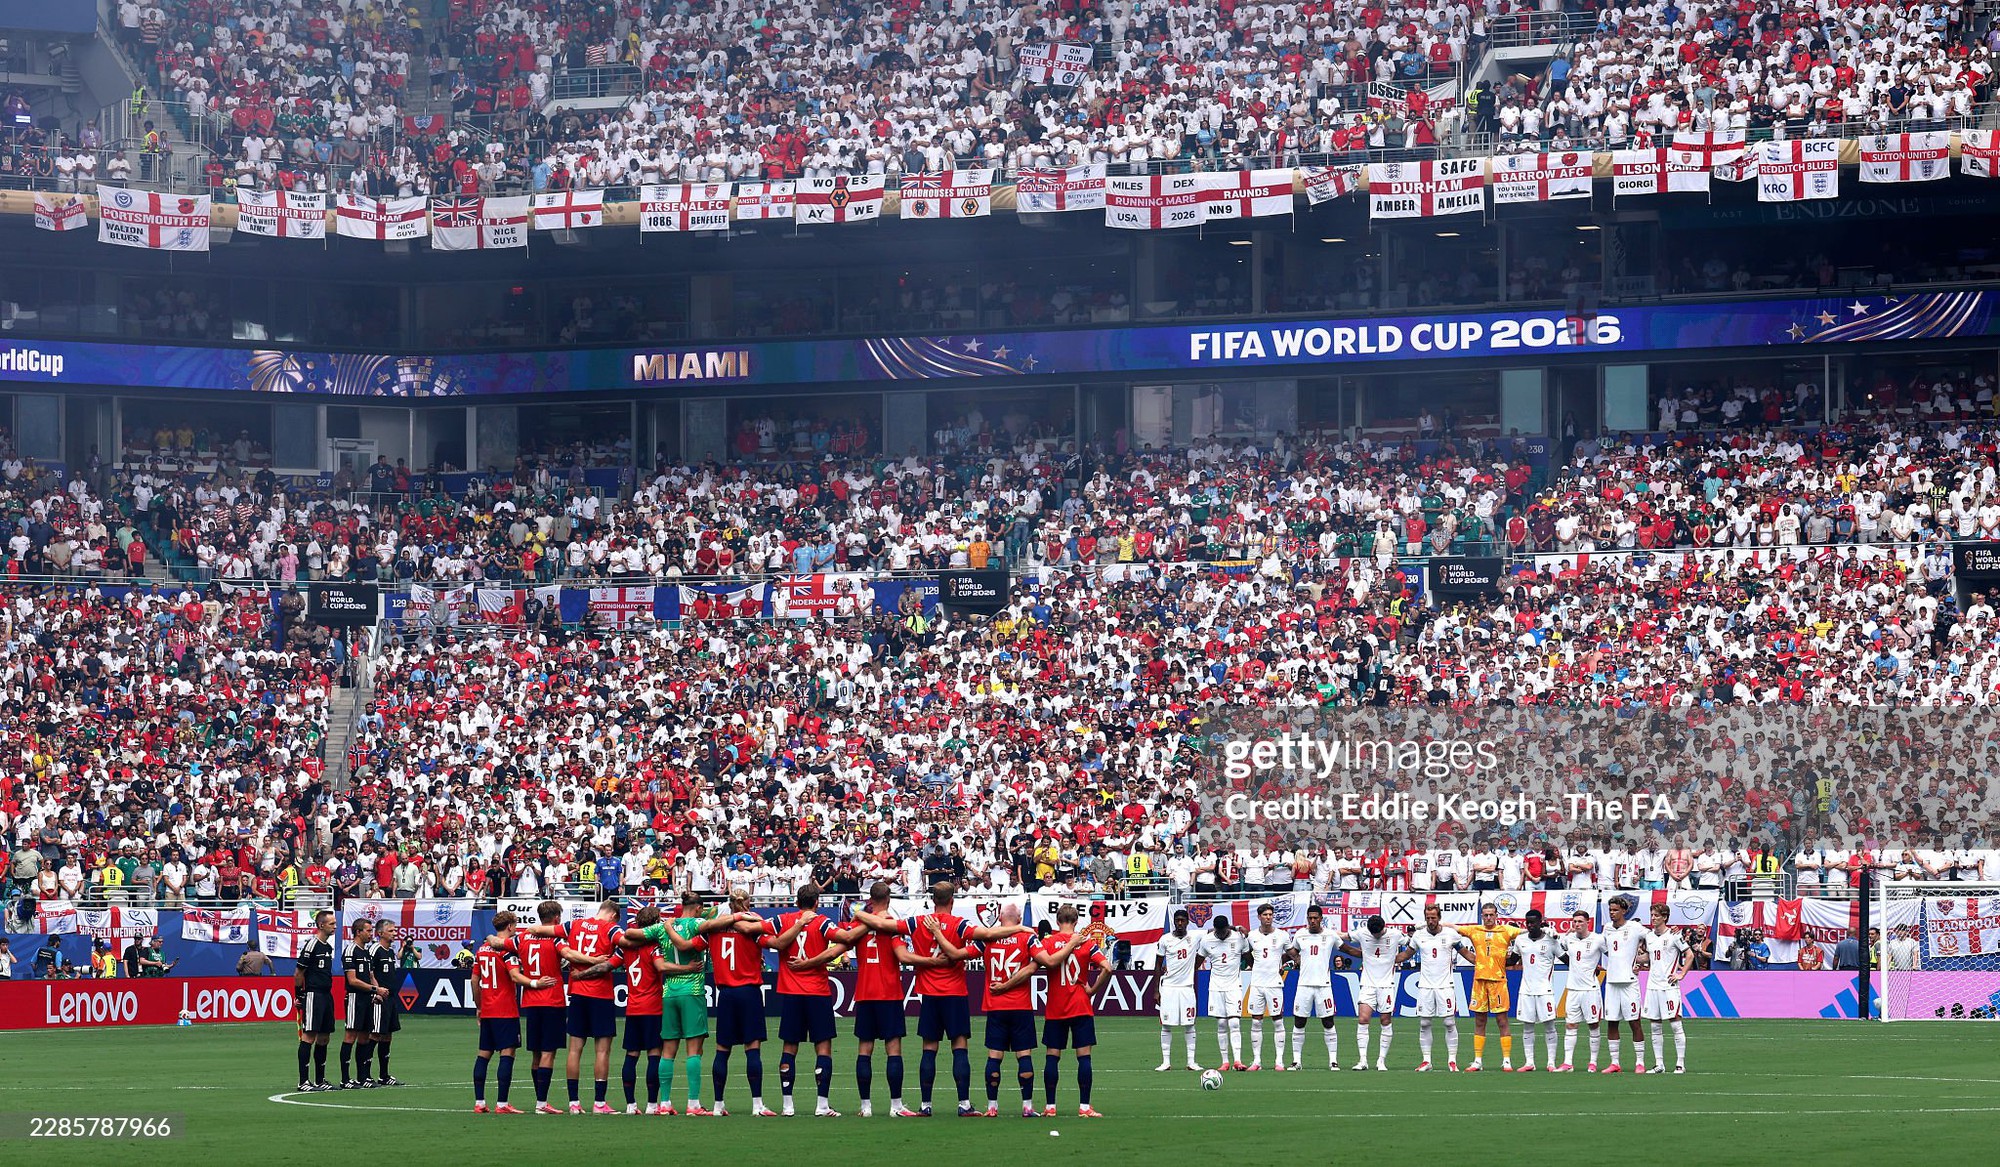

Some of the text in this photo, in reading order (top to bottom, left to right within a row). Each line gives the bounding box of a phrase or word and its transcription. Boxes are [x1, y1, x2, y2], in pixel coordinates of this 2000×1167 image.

[1021, 56, 1084, 72] CHELSEA FC
[1370, 82, 1406, 100] OSSIE
[1805, 142, 1835, 153] BCFC
[1872, 150, 1938, 161] SUTTON UNITED
[1440, 160, 1477, 175] SAFC
[1622, 164, 1660, 174] ILSON
[1761, 162, 1834, 174] REDDITCH BLUES
[1501, 168, 1585, 182] BARROW AFC
[813, 176, 869, 188] WOLVES
[1020, 183, 1065, 192] COVENTRY
[1067, 181, 1088, 190] CITY
[1112, 179, 1194, 190] MILES DEX
[1391, 179, 1463, 194] DURHAM
[1618, 179, 1654, 189] GIORGI
[902, 185, 989, 198] FORDHOUSES WOLVES
[1224, 188, 1269, 199] RAUNDS
[1764, 184, 1788, 194] KRO
[1116, 194, 1196, 206] RUNNING MARE
[1376, 194, 1480, 211] AMBER AMELIA
[646, 201, 724, 212] ARSENAL FC
[808, 205, 874, 218] AY WE
[1209, 206, 1232, 214] NN9
[1776, 198, 1920, 220] ENDZONE
[103, 208, 206, 226] PORTSMOUTH FC
[300, 210, 324, 220] TOWN
[361, 211, 402, 222] FULHAM
[1118, 211, 1195, 222] USA 2026
[258, 217, 276, 226] WHITE
[452, 218, 490, 228] FULHAM
[648, 215, 727, 227] 1886 BENFLEET
[106, 222, 144, 235] WALTON
[396, 230, 418, 238] GUYS
[110, 231, 140, 243] BLUES
[493, 236, 518, 244] GUYS
[1190, 314, 1622, 360] FIFA WORLD CUP 2026
[634, 350, 748, 380] MIAMI
[1528, 445, 1544, 453] 230
[317, 479, 331, 487] 227
[924, 586, 939, 595] 129
[507, 904, 532, 912] Our
[1048, 902, 1148, 917] BECHY'S
[517, 916, 536, 924] ate
[1930, 916, 2000, 931] BLACKPOOL
[80, 926, 154, 938] SHEFFIELD WEDNESDAY
[576, 932, 598, 956] 17
[866, 930, 879, 964] 3
[1613, 941, 1618, 951] 3
[722, 937, 735, 970] 9
[1177, 950, 1187, 959] 20
[1262, 948, 1268, 958] 5
[1310, 945, 1319, 955] 10
[1375, 948, 1380, 958] 4
[1432, 948, 1437, 958] 9
[1486, 946, 1490, 956] 1
[1654, 950, 1661, 961] 18
[528, 944, 541, 976] 5
[1221, 953, 1227, 964] 2
[1530, 954, 1535, 964] 6
[1576, 951, 1581, 961] 8
[990, 948, 1021, 981] 26
[1061, 954, 1080, 986] 10
[480, 957, 497, 988] 21
[628, 955, 642, 986] 6
[46, 982, 292, 1024] Lenovo Lenovo
[1273, 998, 1278, 1008] 5
[1324, 999, 1332, 1010] 10
[1386, 995, 1391, 1005] 4
[1446, 999, 1452, 1010] 9
[1666, 1000, 1675, 1011] 18
[1186, 1007, 1195, 1018] 20
[1547, 1002, 1552, 1012] 6
[1591, 1005, 1597, 1016] 8
[1631, 1002, 1636, 1013] 3
